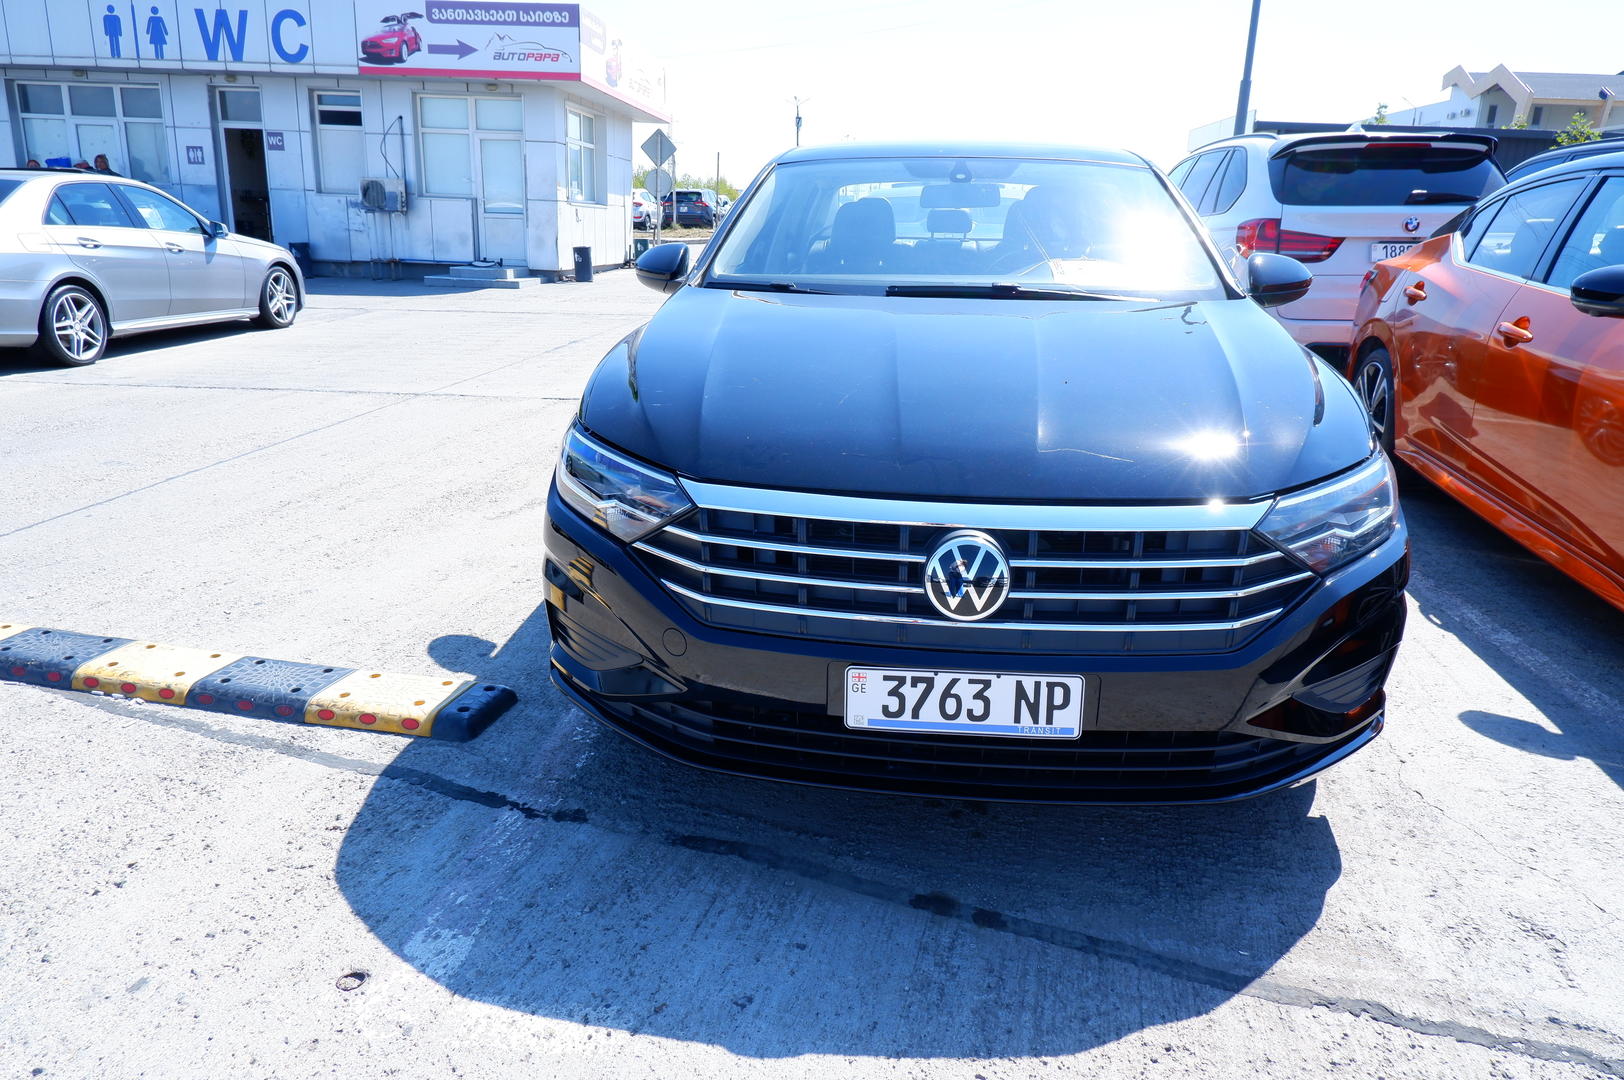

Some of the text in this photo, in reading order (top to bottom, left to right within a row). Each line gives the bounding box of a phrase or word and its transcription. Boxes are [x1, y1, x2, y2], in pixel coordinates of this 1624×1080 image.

[431, 8, 517, 21] ვანთავსებთ
[519, 10, 570, 24] საიტზე
[268, 136, 282, 145] WC
[852, 683, 866, 693] GE
[882, 675, 1071, 725] 3763 NP
[1018, 726, 1062, 735] TRANSIT
